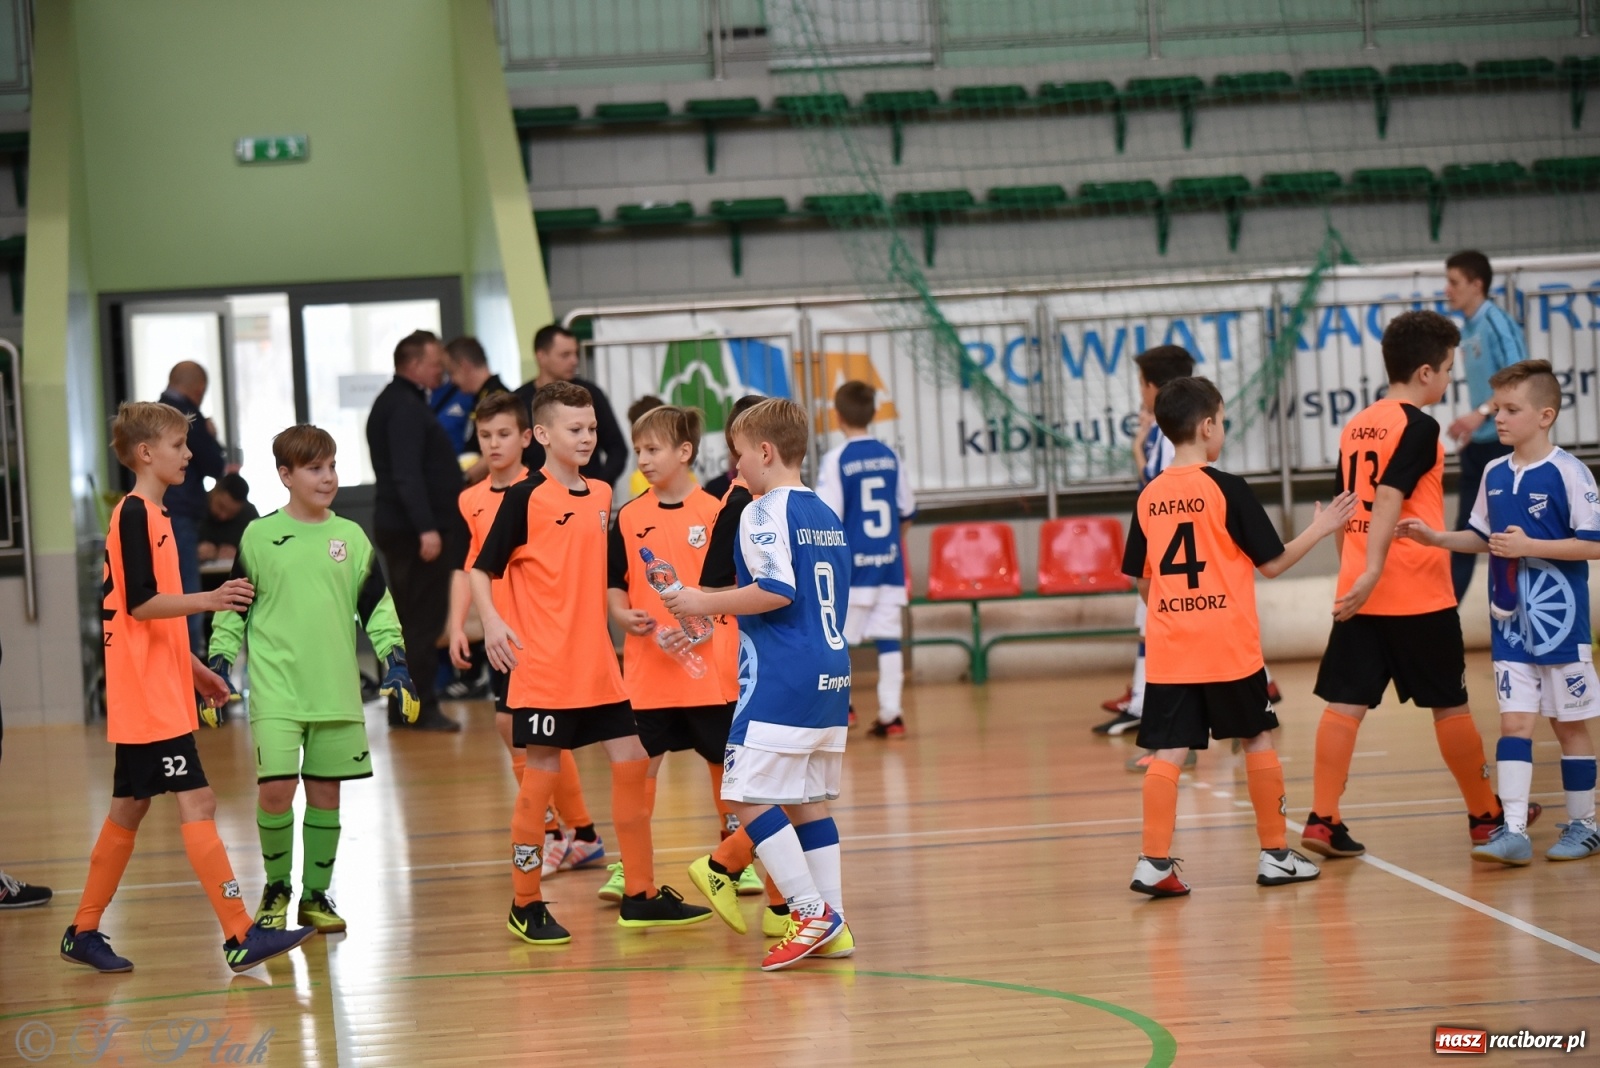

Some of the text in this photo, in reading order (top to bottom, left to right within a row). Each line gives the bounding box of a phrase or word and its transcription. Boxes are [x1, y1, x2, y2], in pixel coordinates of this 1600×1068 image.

[1350, 427, 1388, 441] RAFAKO
[860, 476, 891, 538] 5
[1149, 498, 1205, 516] RAFAKO
[1159, 521, 1207, 590] 4
[813, 561, 844, 650] 8
[1495, 670, 1512, 700] 14
[528, 713, 556, 737] 10
[162, 755, 188, 777] 32
